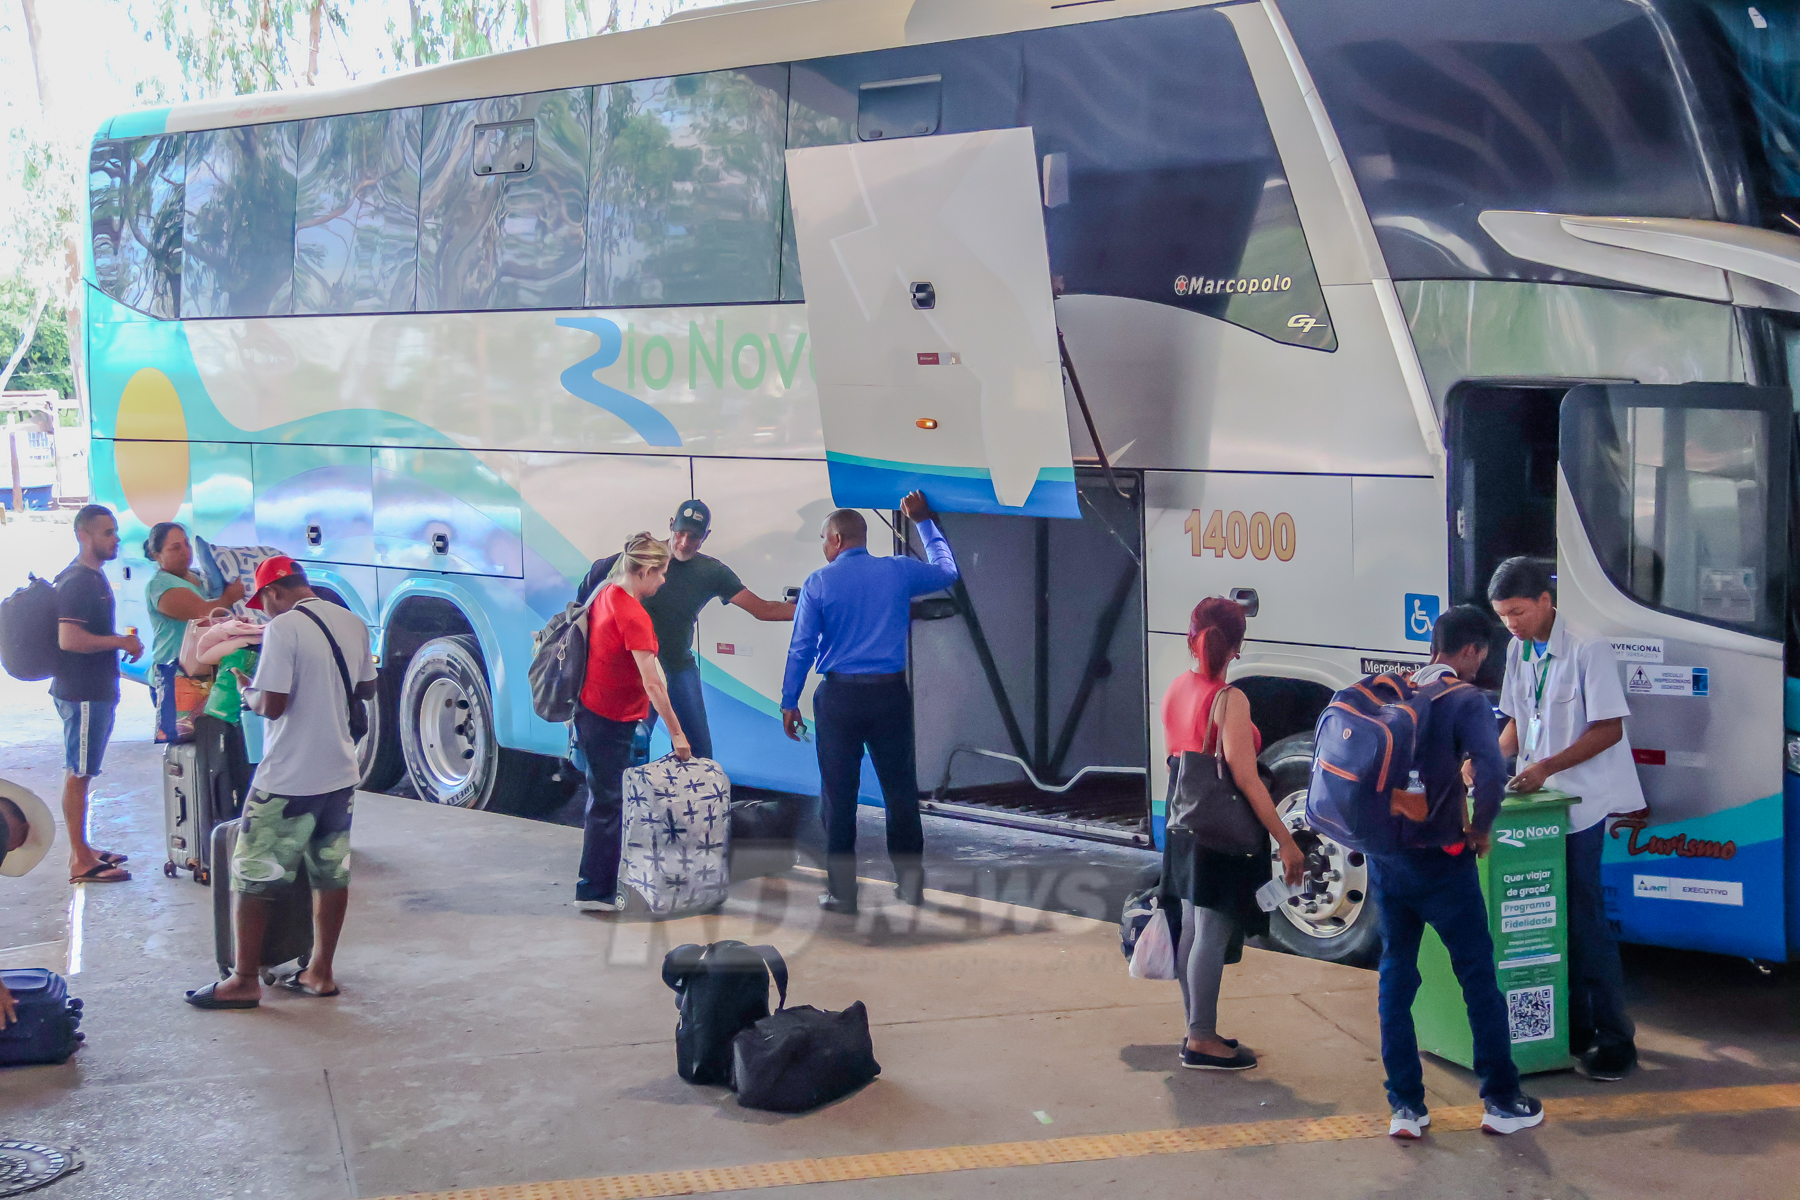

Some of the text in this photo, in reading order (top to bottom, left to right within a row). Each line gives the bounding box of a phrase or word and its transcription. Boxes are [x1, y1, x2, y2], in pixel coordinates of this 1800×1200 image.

[1188, 274, 1292, 295] Marcopolo
[1287, 314, 1328, 333] G7
[555, 317, 818, 447] Rio Nov
[1184, 508, 1296, 562] 14000
[1496, 825, 1560, 848] Rio Novo
[1609, 820, 1737, 860] Turismo
[1503, 870, 1551, 884] Quer viajar
[1506, 883, 1551, 898] de graça?
[1682, 886, 1729, 896] EXECUTIVO
[1504, 901, 1551, 913] Programa
[1504, 916, 1553, 929] Fidelidade
